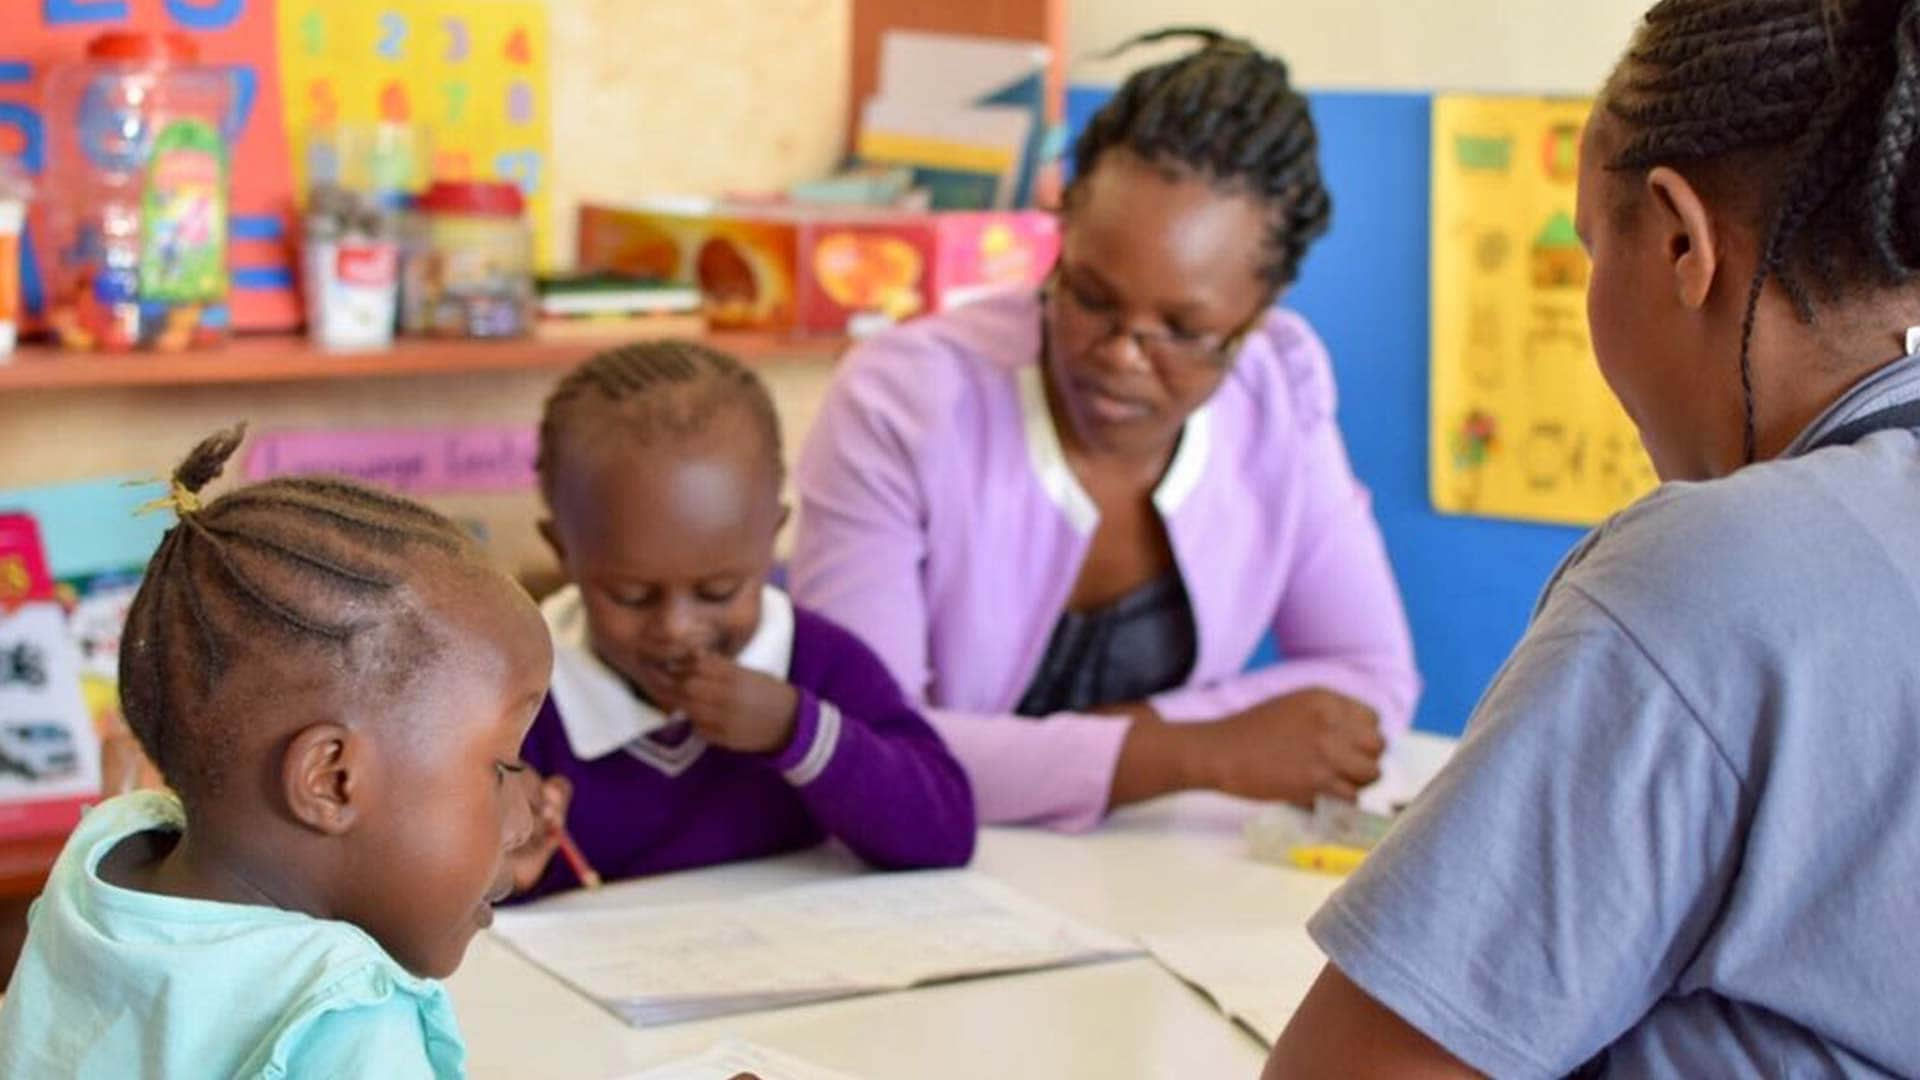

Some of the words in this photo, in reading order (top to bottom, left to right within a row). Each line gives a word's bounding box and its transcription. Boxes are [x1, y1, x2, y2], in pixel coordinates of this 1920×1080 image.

[375, 10, 408, 60] 2
[440, 17, 472, 64] 3
[504, 26, 533, 66] 4
